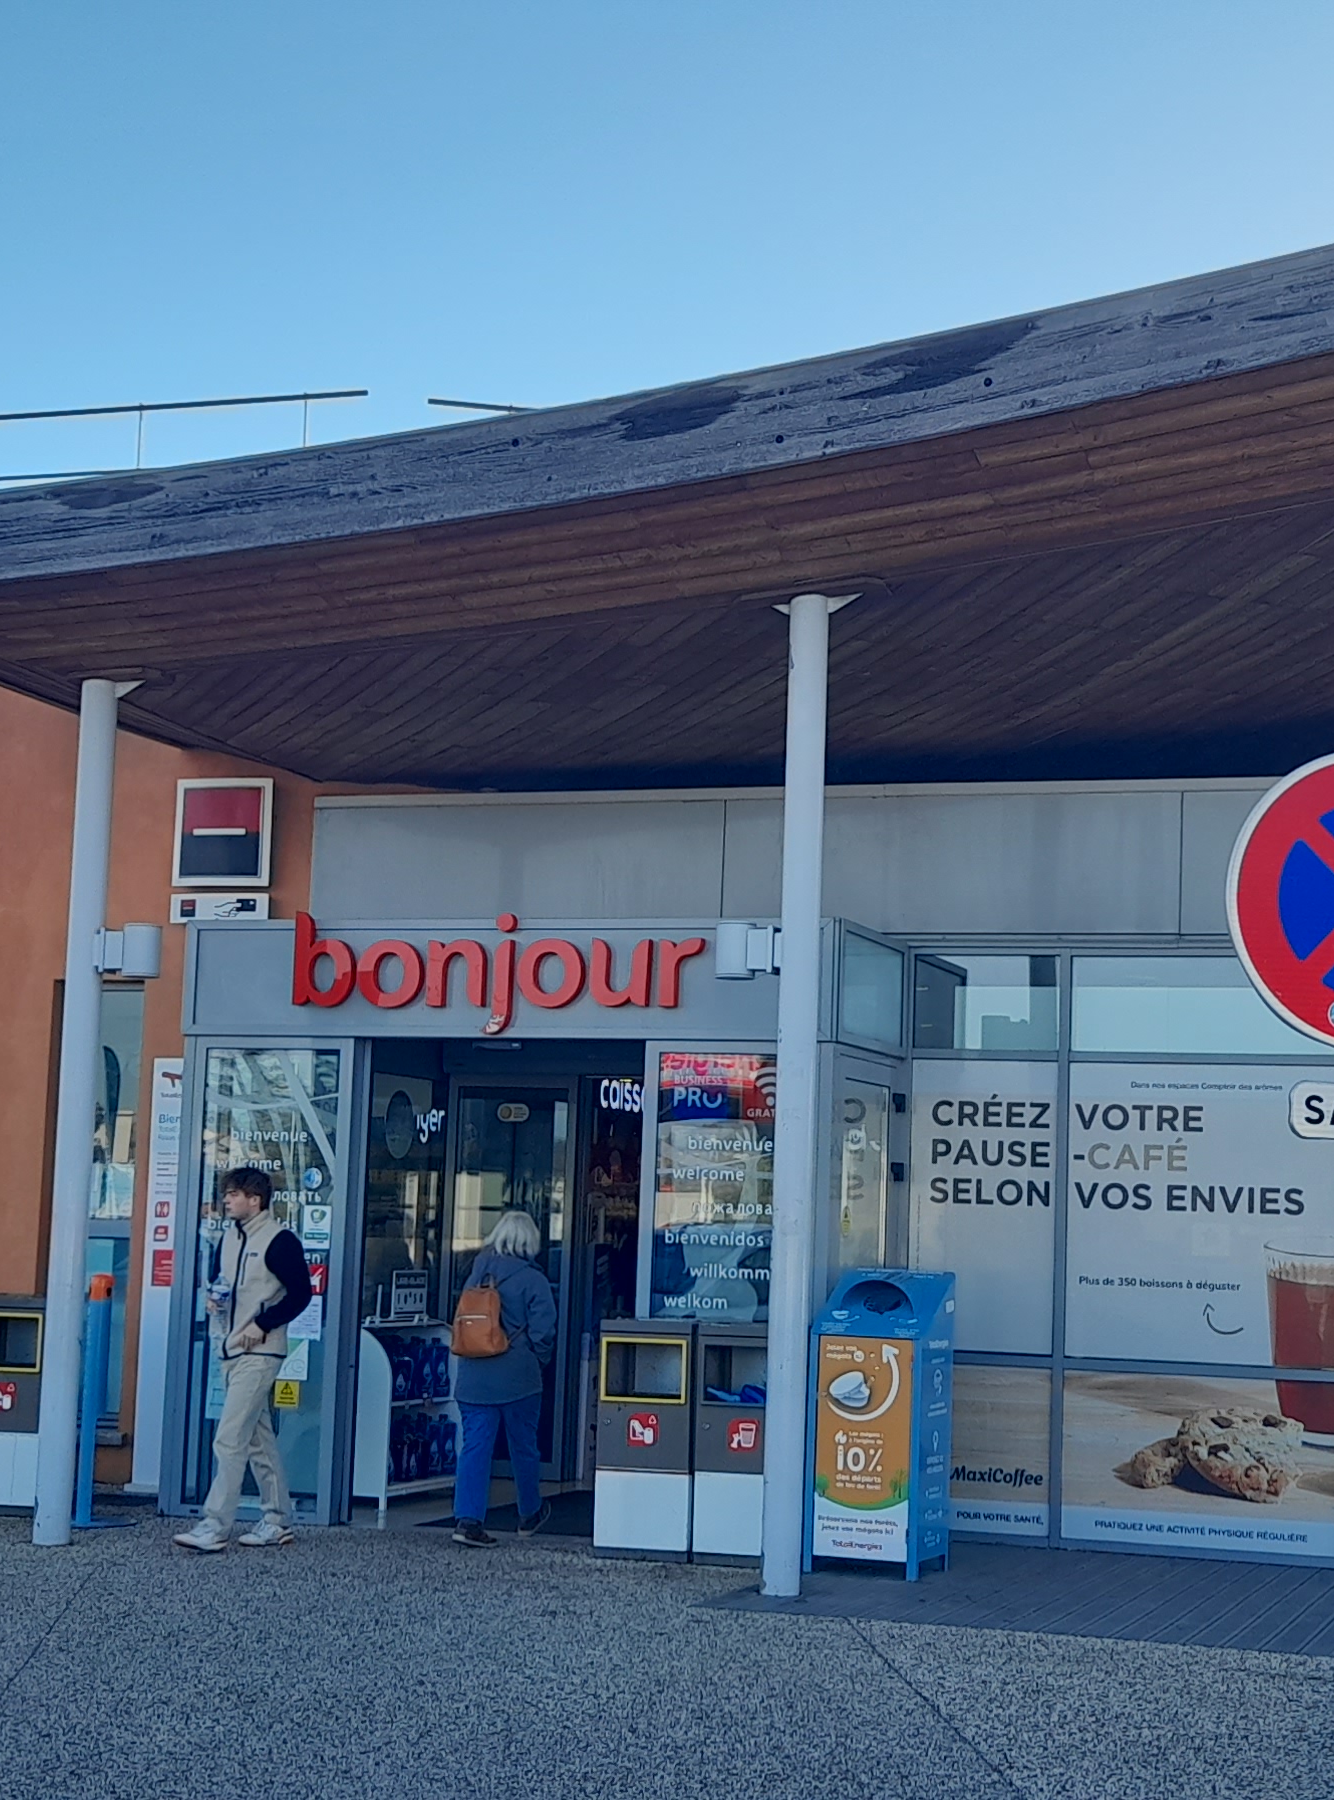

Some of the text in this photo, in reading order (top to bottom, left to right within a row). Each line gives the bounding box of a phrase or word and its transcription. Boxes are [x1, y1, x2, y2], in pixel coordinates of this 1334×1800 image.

[292, 910, 706, 1035] bonjour
[674, 1075, 723, 1085] BUSINESS
[600, 1079, 646, 1113] caiss
[931, 1093, 1204, 1133] CRÉEZ VOTRE
[231, 1127, 308, 1143] bienvenue
[688, 1135, 773, 1151] bienvenue
[931, 1138, 1051, 1168] PAUSE
[672, 1167, 744, 1182] welcome
[272, 1190, 321, 1202] ловать
[930, 1177, 1304, 1216] SELON VOS ENVIES
[692, 1201, 773, 1215] пожалова
[664, 1229, 765, 1247] bienvenidos
[689, 1263, 770, 1281] willkomm
[1079, 1275, 1241, 1292] Plus de 350 boissons à déguster
[664, 1294, 728, 1310] welkom
[837, 1445, 883, 1472] 10%
[949, 1465, 1043, 1488] MaxiCoffee
[956, 1511, 981, 1521] POUR
[983, 1512, 1012, 1523] VOTRE
[1094, 1519, 1143, 1532] PRATIQUEZ
[1146, 1524, 1164, 1533] UNE
[1166, 1524, 1206, 1536] ACTIVITÉ
[1208, 1527, 1254, 1539] PHYSIQUE
[1256, 1530, 1308, 1543] RÉGULIÈRE
